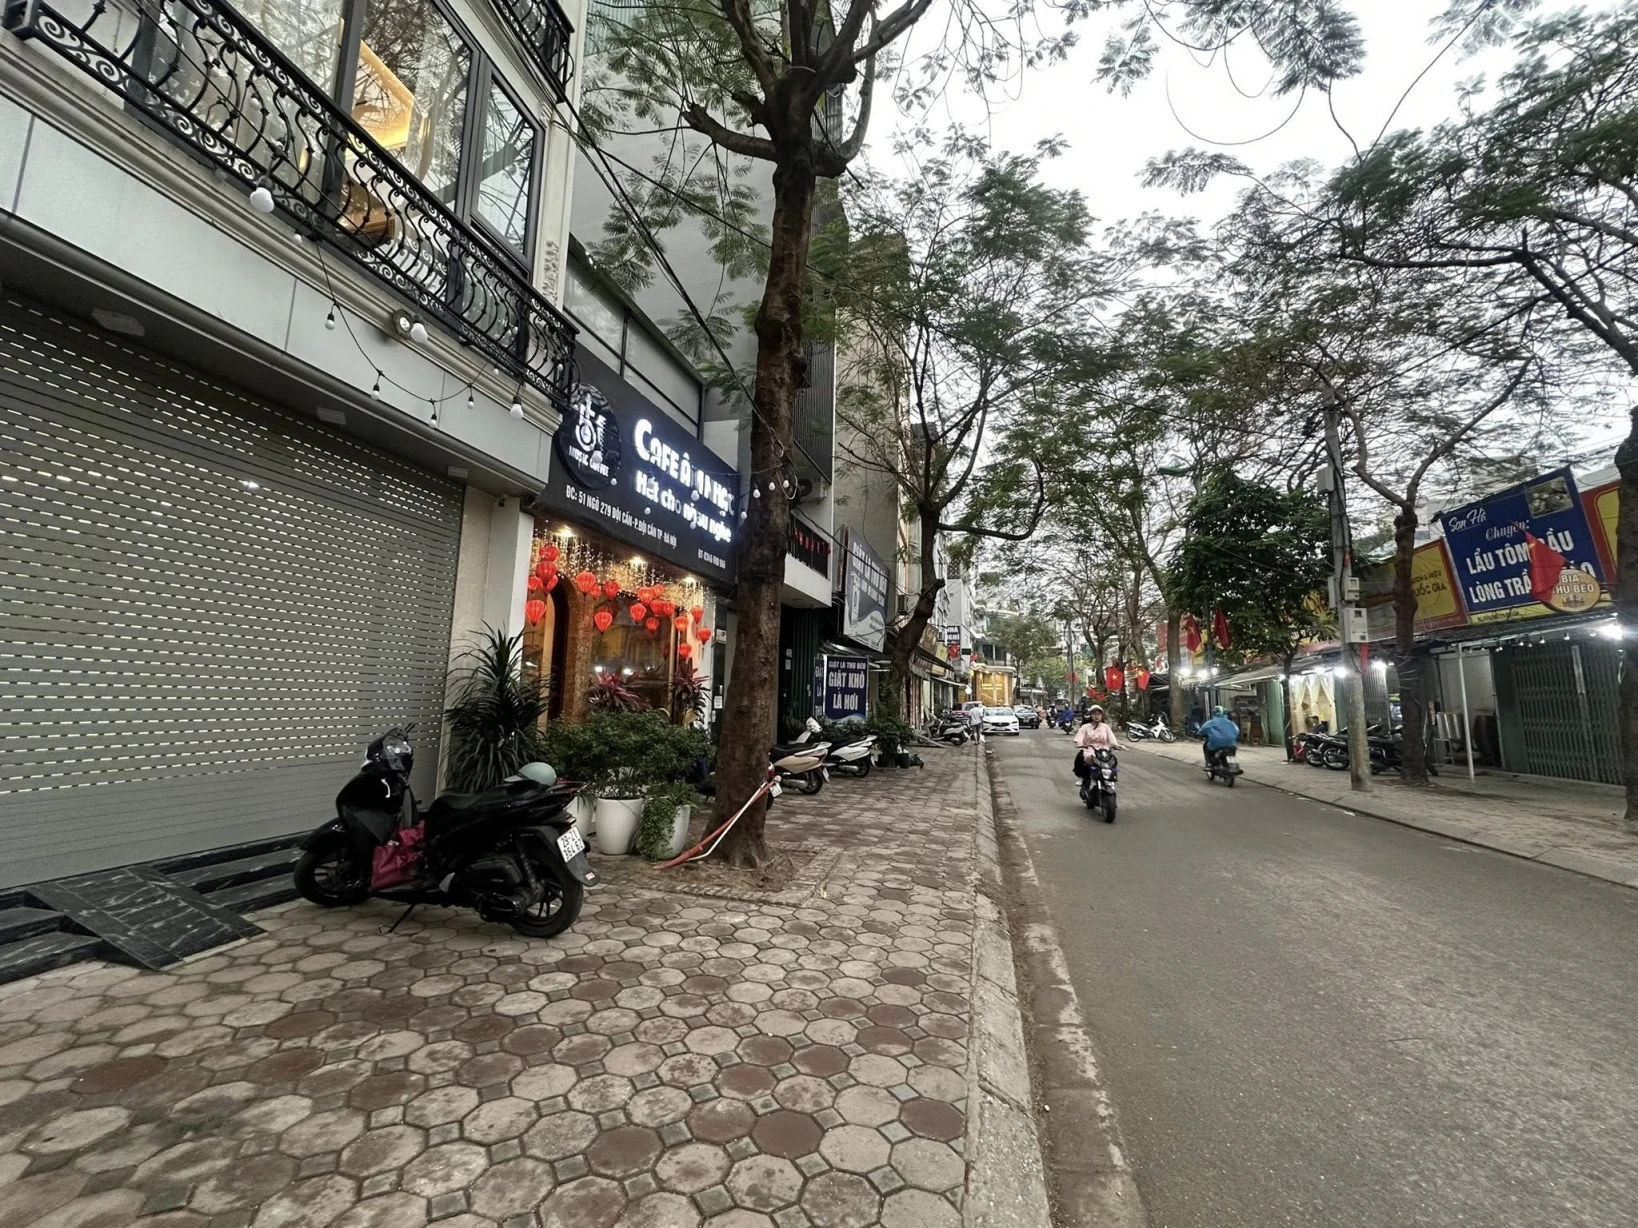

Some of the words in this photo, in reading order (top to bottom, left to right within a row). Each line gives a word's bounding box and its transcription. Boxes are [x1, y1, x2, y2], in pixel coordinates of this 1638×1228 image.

[635, 419, 680, 480] CAFE
[578, 490, 586, 505] 51
[600, 501, 612, 517] 279
[1561, 574, 1580, 583] BIA
[1468, 581, 1505, 604] LÒNG
[828, 670, 847, 690] GIẶT
[833, 691, 842, 709] LÀ
[844, 692, 859, 711] HƠI
